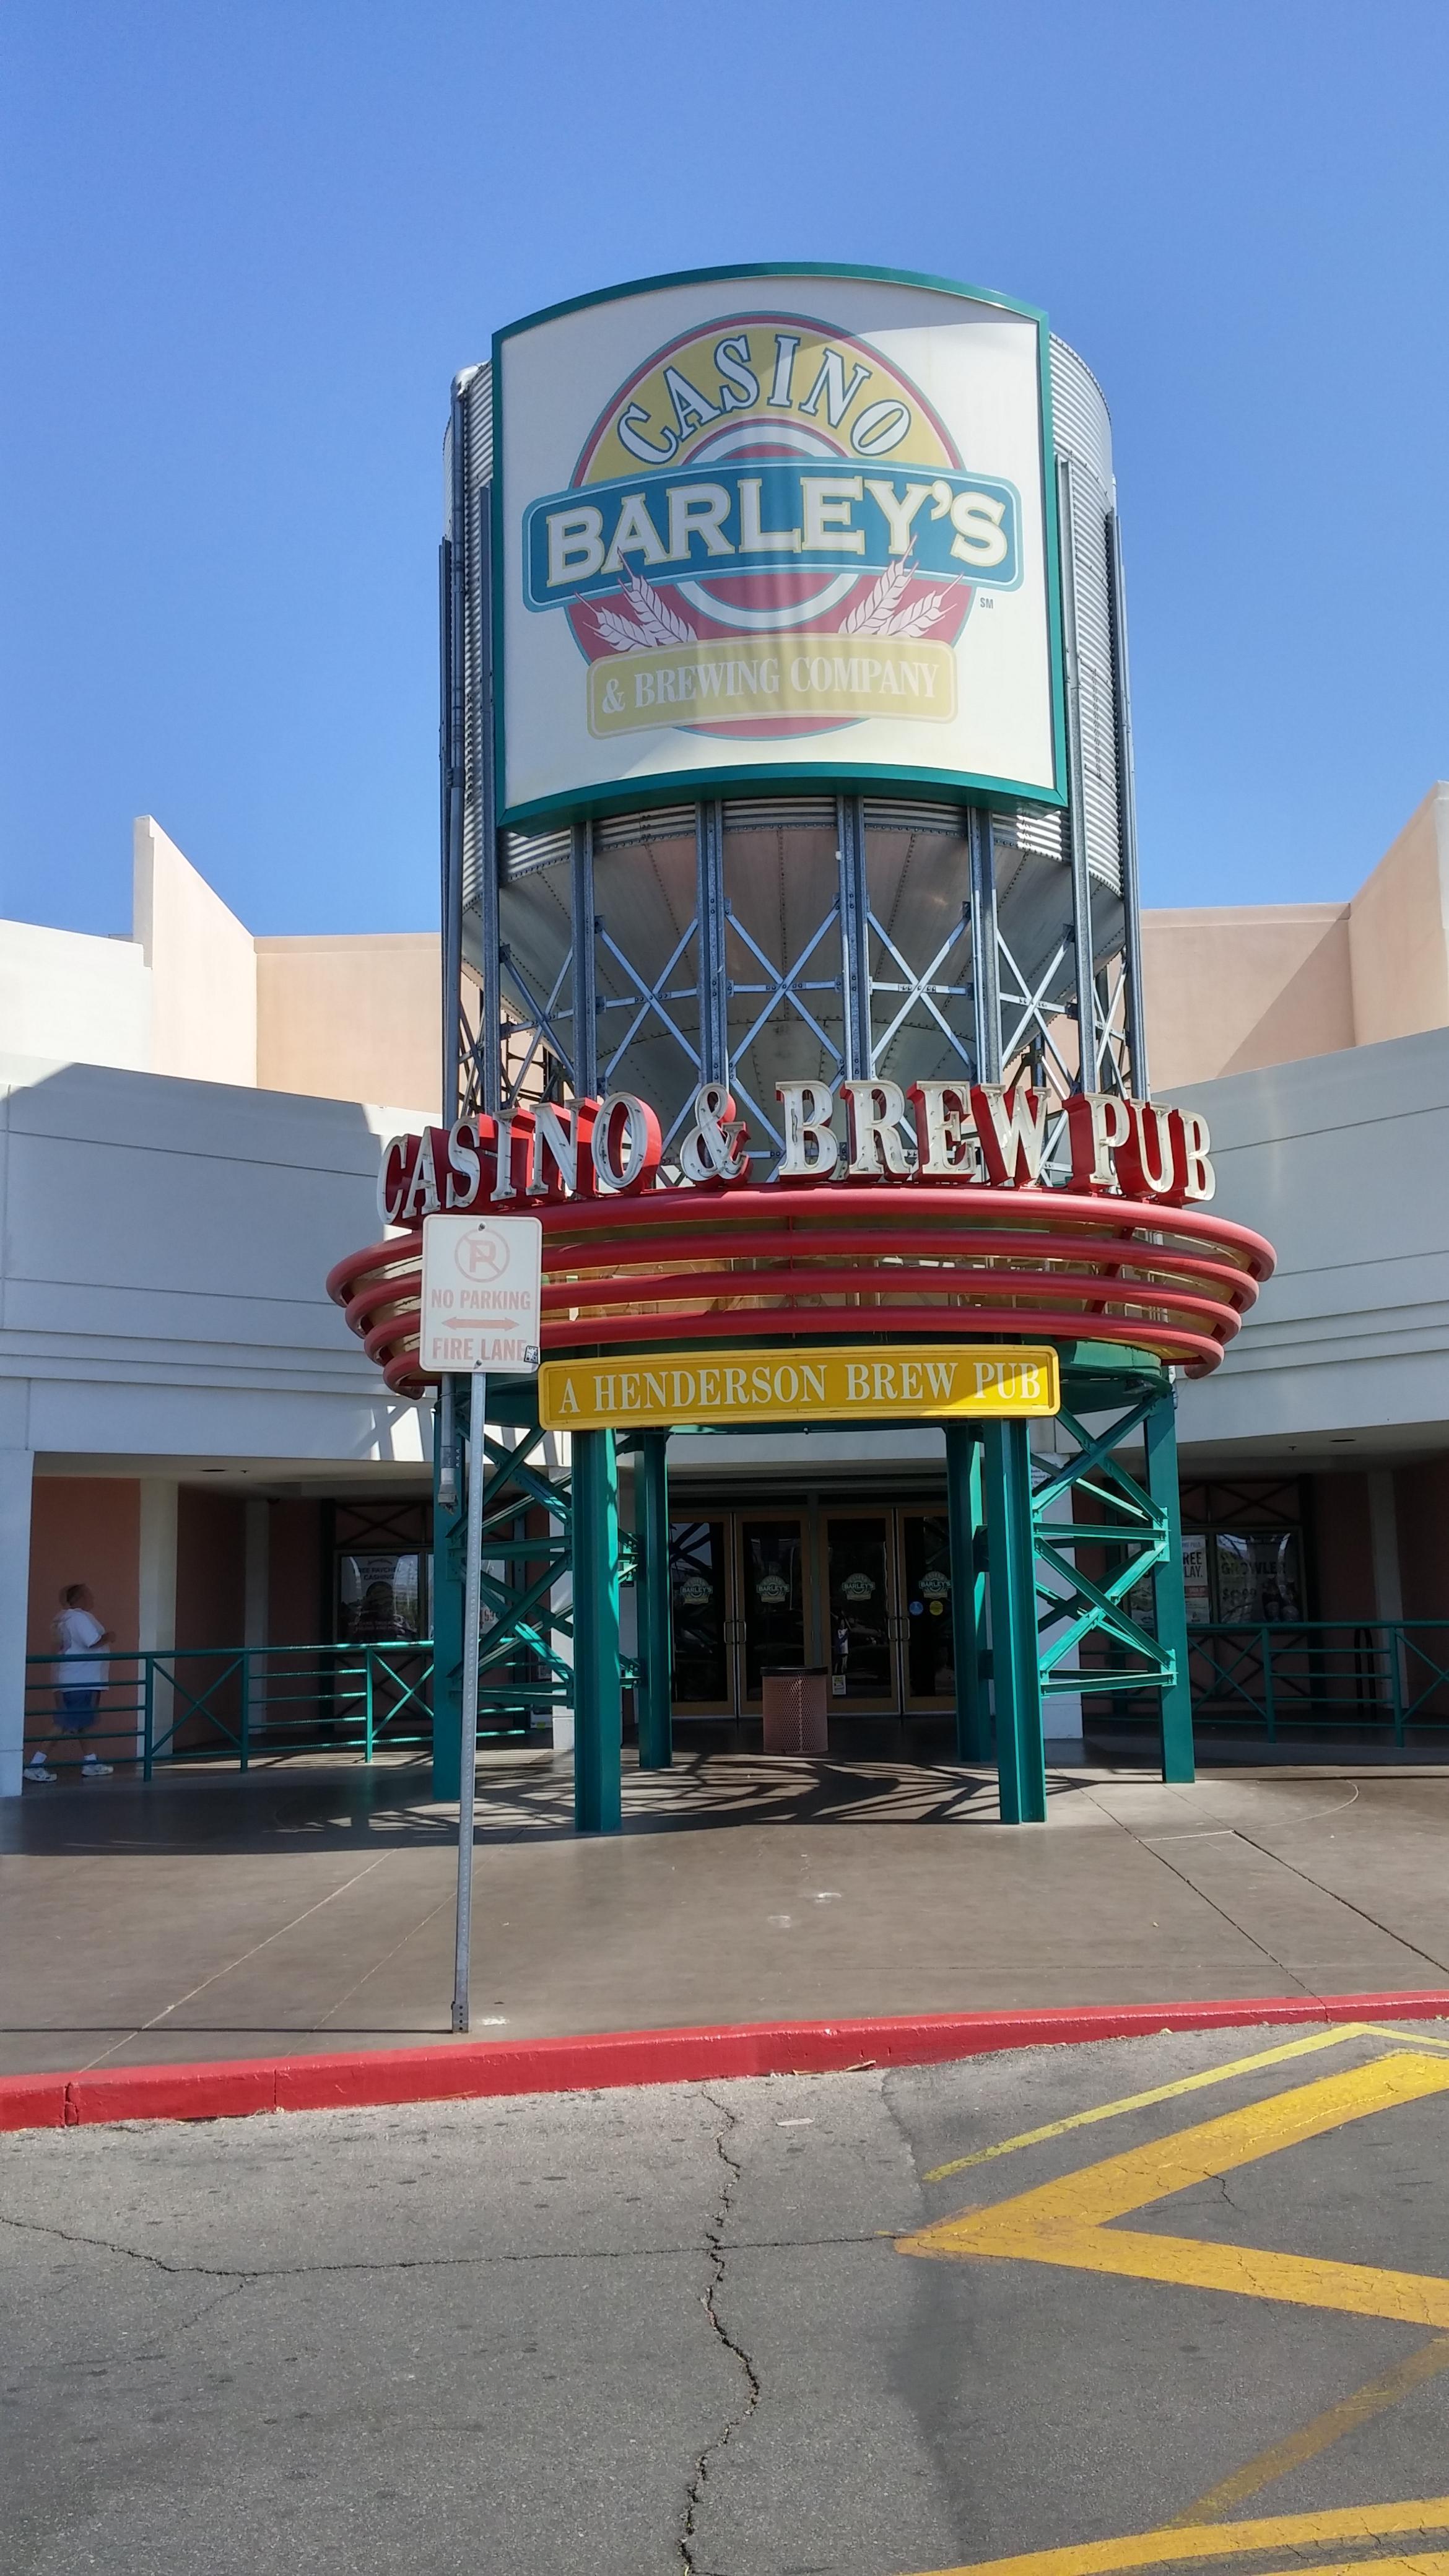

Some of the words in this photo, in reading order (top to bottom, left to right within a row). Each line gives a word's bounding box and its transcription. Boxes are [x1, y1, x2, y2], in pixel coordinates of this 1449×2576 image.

[618, 334, 912, 464] CASINO
[547, 476, 1008, 587] BARLEY'S
[980, 597, 993, 609] SM
[601, 678, 625, 714] &
[634, 658, 779, 709] BREWING
[790, 656, 940, 698] COMPANY
[376, 1091, 661, 1226] CASINO
[680, 1082, 751, 1185] &
[775, 1080, 1052, 1186] BREW
[1065, 1092, 1217, 1203] PUB
[432, 1289, 454, 1308] NO
[460, 1290, 531, 1310] PARKING
[433, 1338, 474, 1360] FIRE
[481, 1339, 526, 1361] LANE
[559, 1378, 580, 1414] A
[594, 1365, 827, 1411] HENDERSON
[845, 1363, 957, 1401] BREW
[975, 1362, 1043, 1399] PUB
[1183, 1552, 1202, 1565] REE
[1184, 1565, 1203, 1577] LAY.
